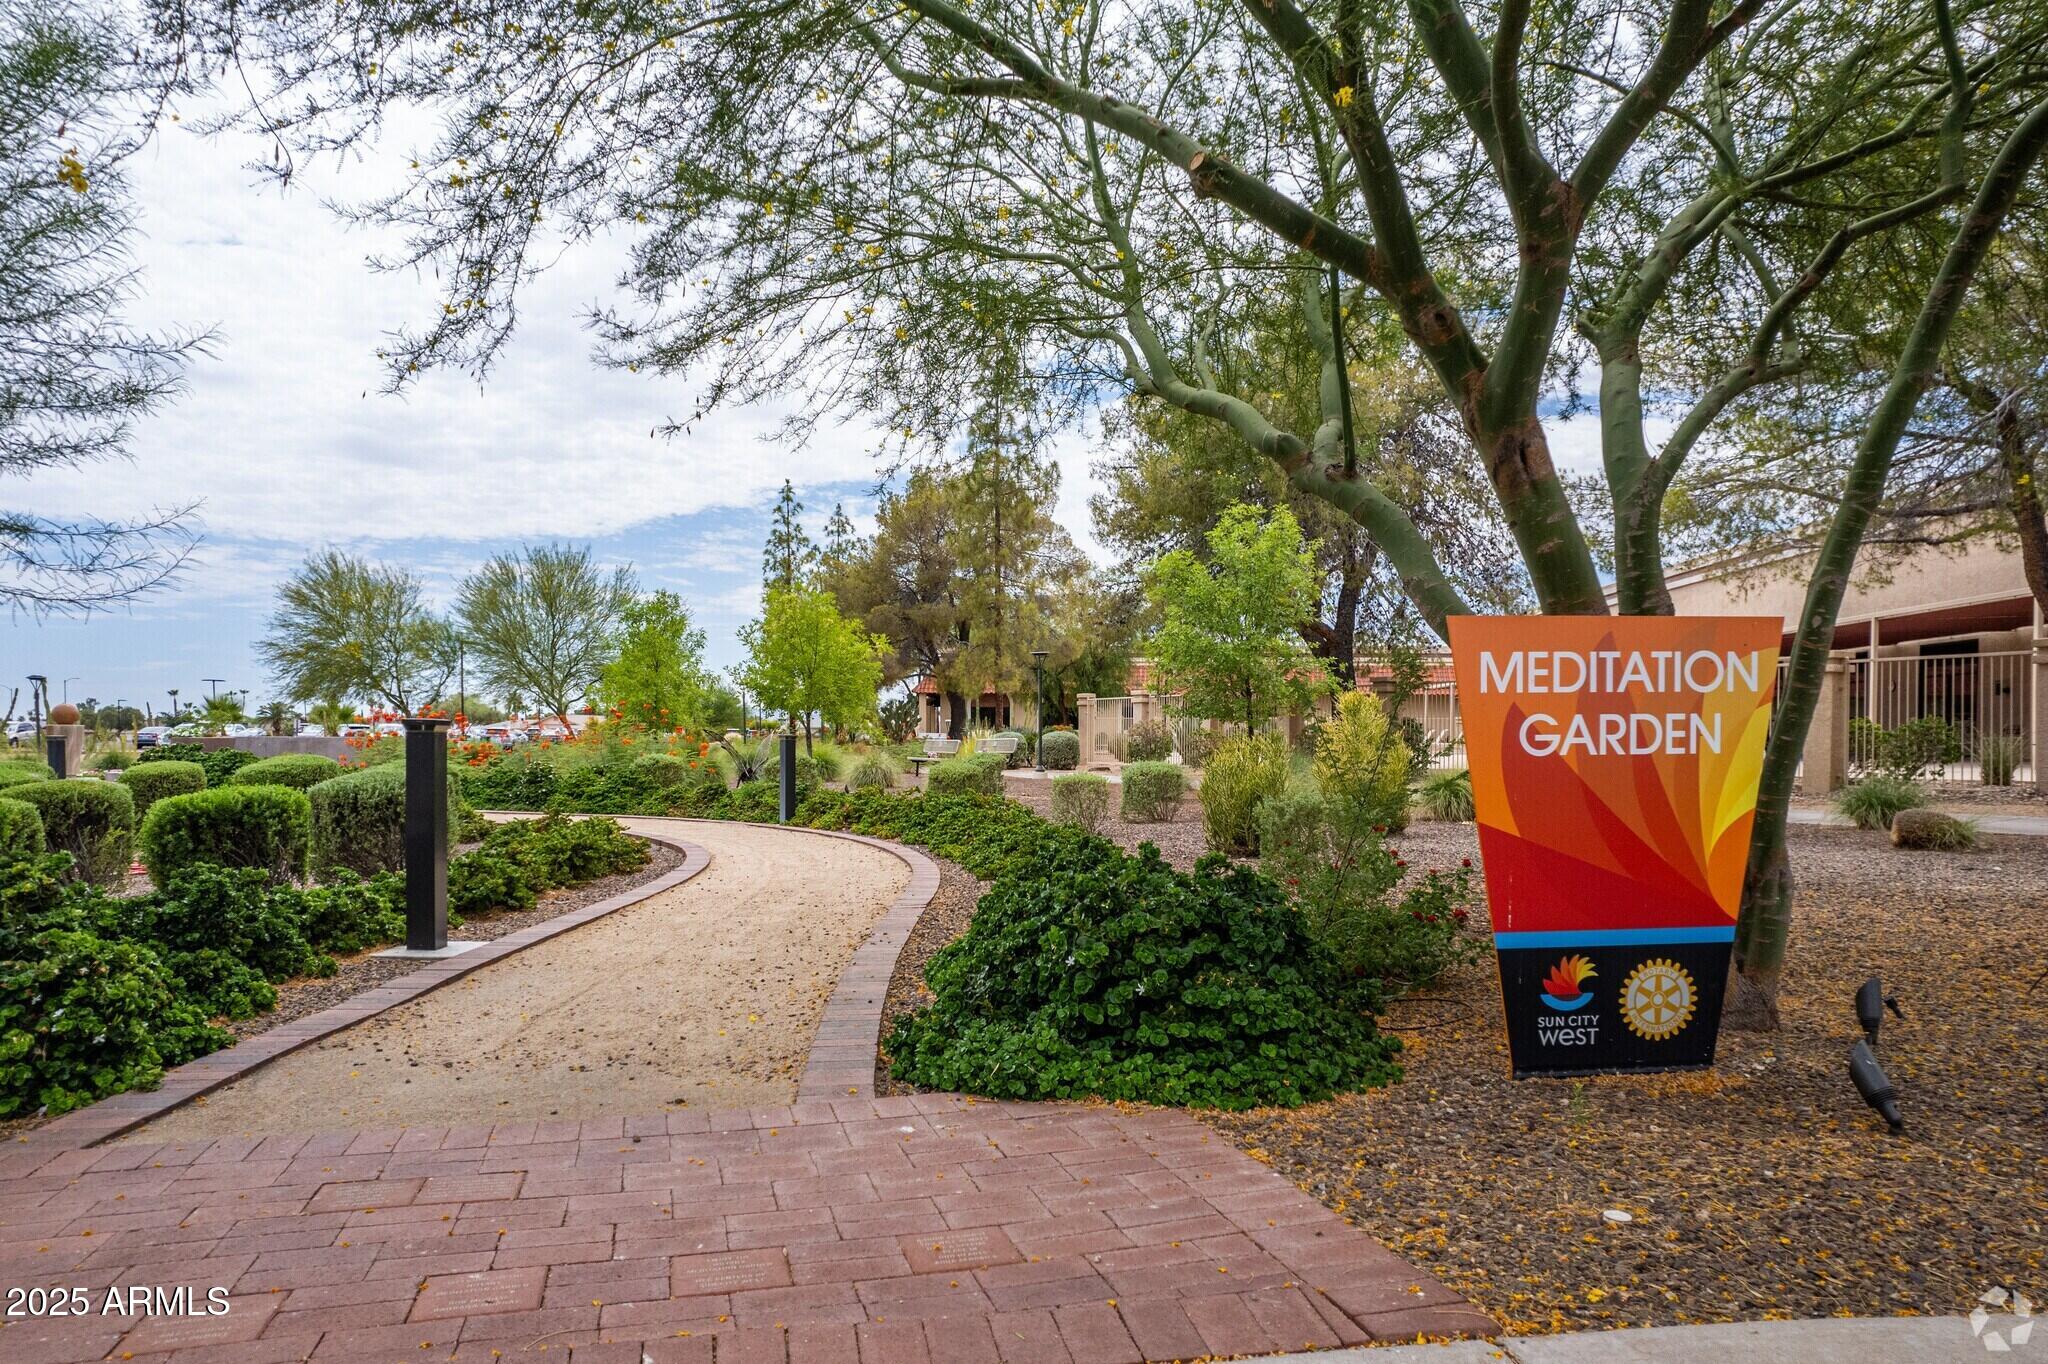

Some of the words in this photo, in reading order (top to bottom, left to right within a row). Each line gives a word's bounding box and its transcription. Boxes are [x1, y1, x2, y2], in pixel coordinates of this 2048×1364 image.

[1480, 650, 1759, 693] MEDITATION
[1519, 712, 1722, 757] GARDEN
[1642, 967, 1675, 978] ROTARY
[1537, 1016, 1565, 1028] SUN
[1568, 1015, 1600, 1027] CITY
[1630, 1008, 1687, 1032] INTERNATIONAL
